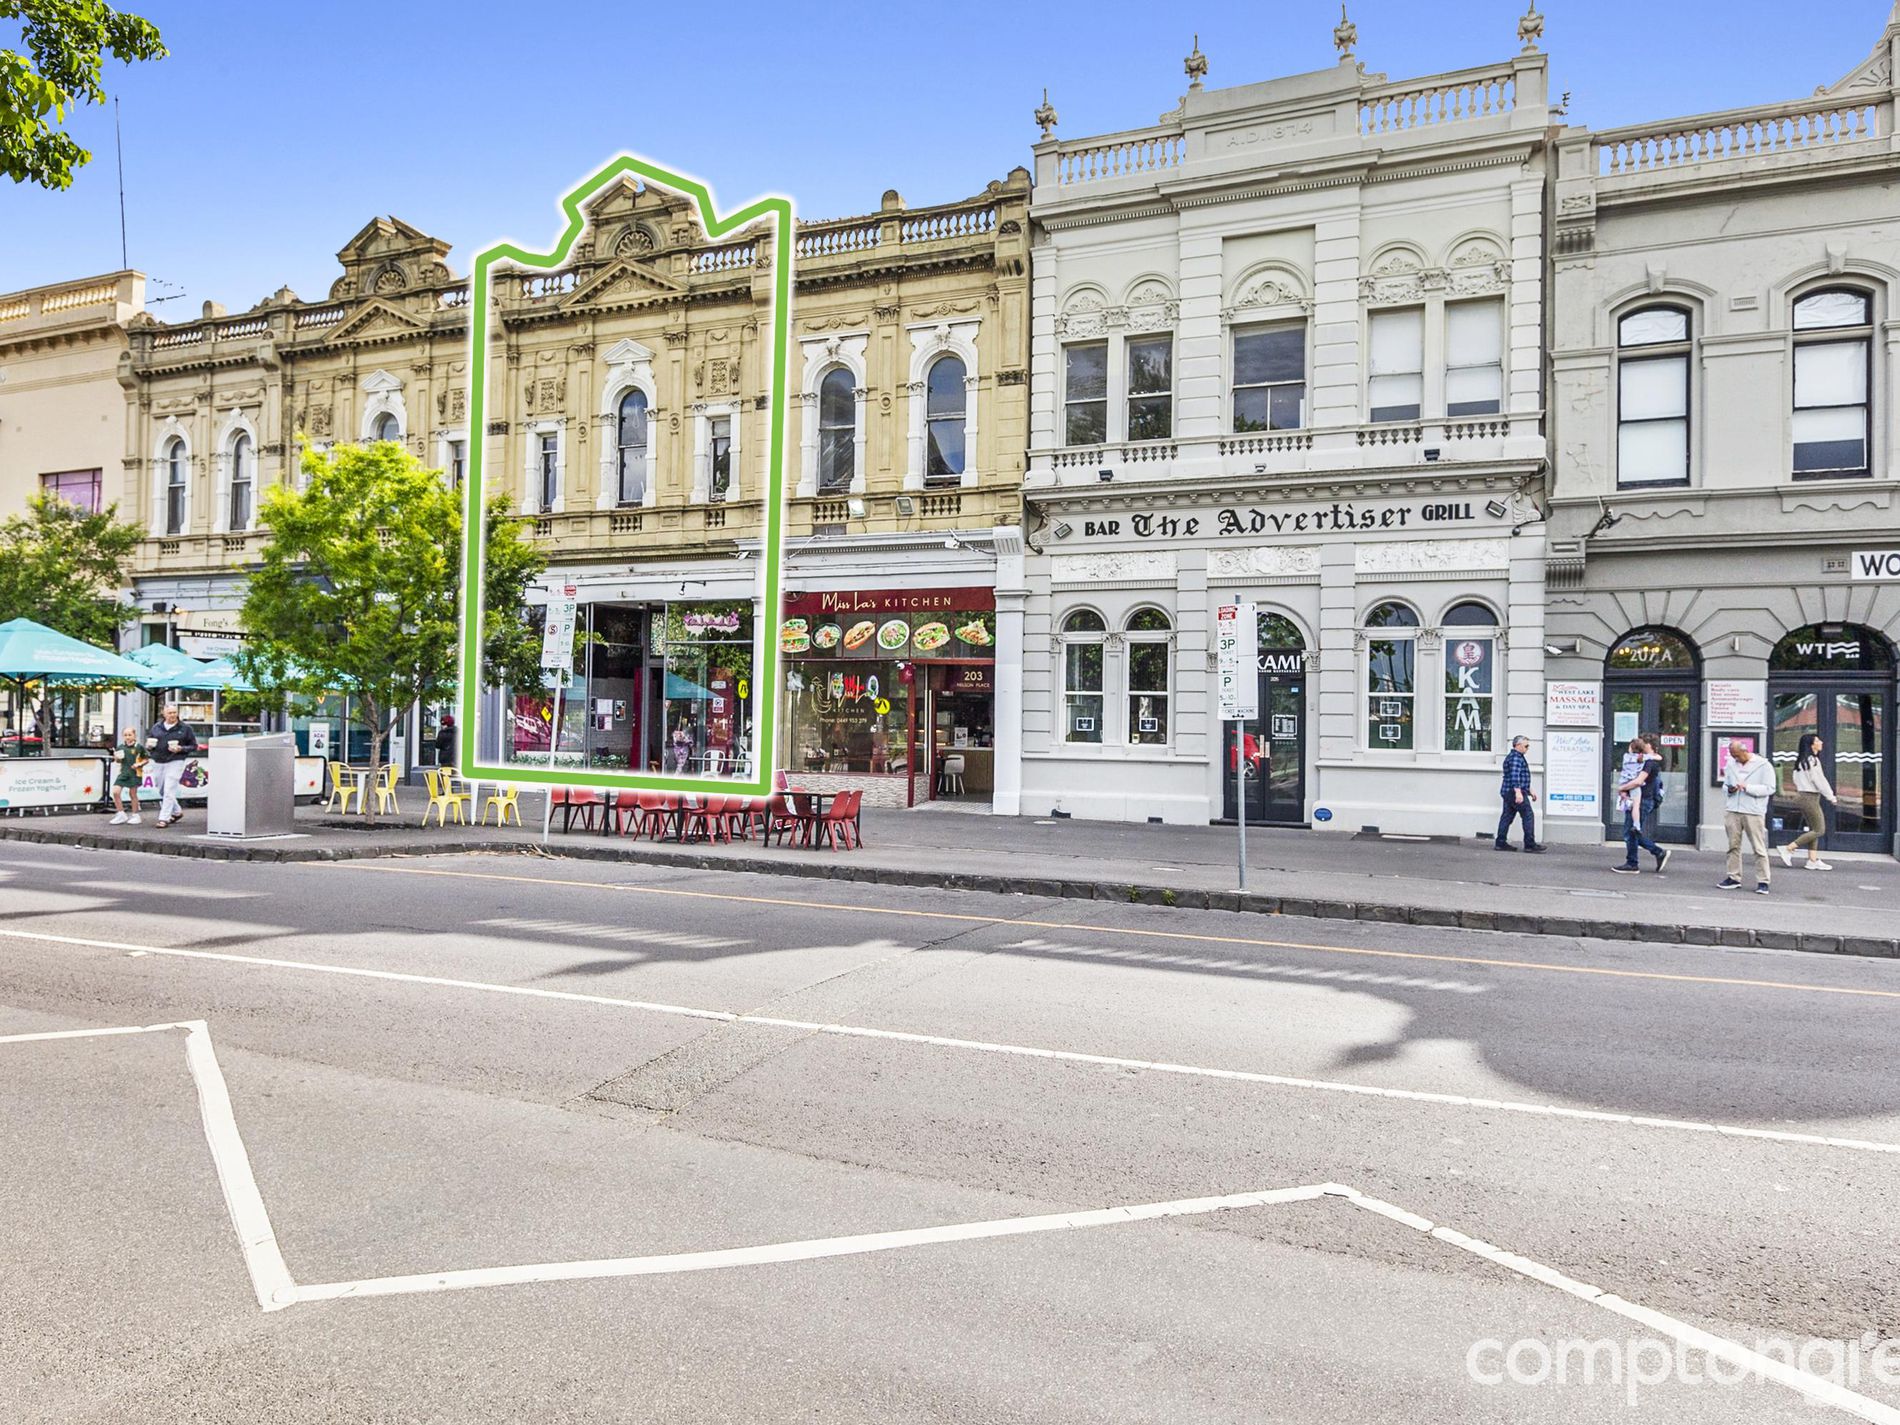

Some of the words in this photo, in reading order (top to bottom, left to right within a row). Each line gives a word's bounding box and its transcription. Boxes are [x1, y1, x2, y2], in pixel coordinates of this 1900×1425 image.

[1084, 519, 1120, 537] BAR
[1131, 512, 1200, 538] The
[1217, 502, 1412, 536] Advertiser
[1421, 502, 1475, 521] GRILL
[1860, 553, 1900, 577] WO
[822, 592, 851, 612] Miss
[854, 591, 877, 611] La's
[884, 596, 951, 607] KITCHEN
[563, 603, 575, 613] 3P
[203, 617, 229, 629] Fong's
[563, 624, 571, 633] P
[1220, 638, 1235, 650] 3P
[1257, 654, 1300, 670] KAMI
[964, 671, 983, 681] 203
[1223, 676, 1232, 687] P
[1550, 696, 1596, 704] MASSAGE
[1454, 665, 1482, 751] KAMI
[1664, 736, 1684, 745] OPEN
[36, 784, 67, 792] Yoghurt
